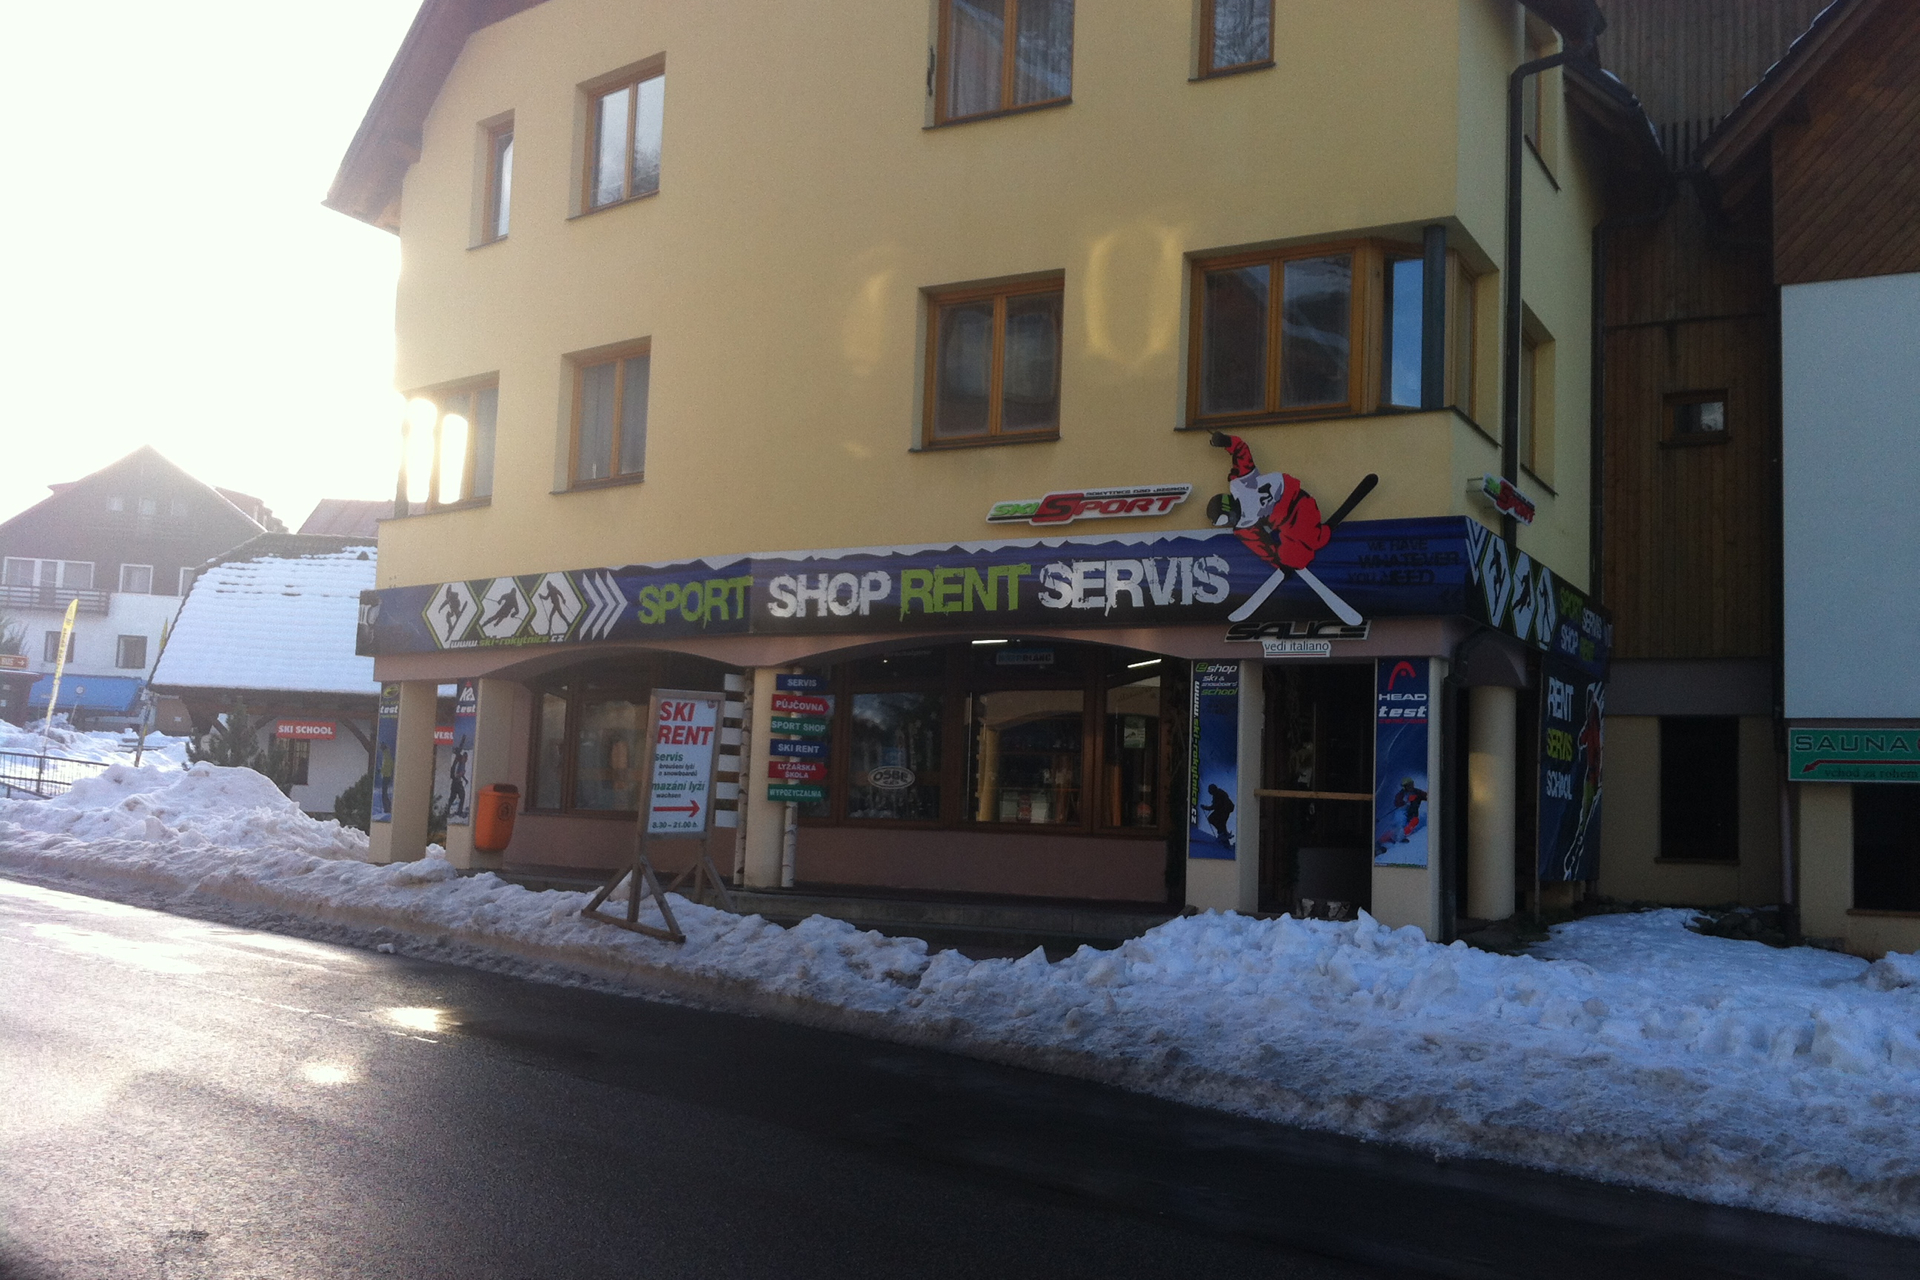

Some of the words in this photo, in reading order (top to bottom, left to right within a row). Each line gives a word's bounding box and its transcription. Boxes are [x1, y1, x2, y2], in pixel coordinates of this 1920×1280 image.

[1390, 539, 1427, 550] HAVE
[1358, 551, 1460, 568] WHATEVER
[638, 575, 754, 629] SPORT
[767, 570, 893, 619] SHOP
[900, 562, 1034, 623] RENT
[1039, 553, 1231, 617] SERVIS
[450, 634, 565, 648] www.ski-rokytnice.cz
[1265, 641, 1286, 651] vedi
[1290, 640, 1330, 651] italiano
[787, 679, 818, 687] SERVIS
[1201, 687, 1239, 695] school
[1378, 693, 1427, 701] HEAD
[776, 698, 824, 712] PŮJČOVNA
[1547, 676, 1574, 722] RENT
[659, 701, 696, 722] SKI
[1378, 705, 1427, 717] test
[278, 725, 294, 733] SKI
[295, 725, 333, 735] SCHOOL
[772, 720, 801, 731] SPORT
[803, 723, 826, 732] SHOP
[657, 725, 714, 745] RENT
[778, 743, 793, 752] SKI
[795, 744, 820, 753] RENT
[1794, 735, 1912, 752] SAUNA
[655, 752, 684, 762] servis
[652, 780, 687, 791] mazání
